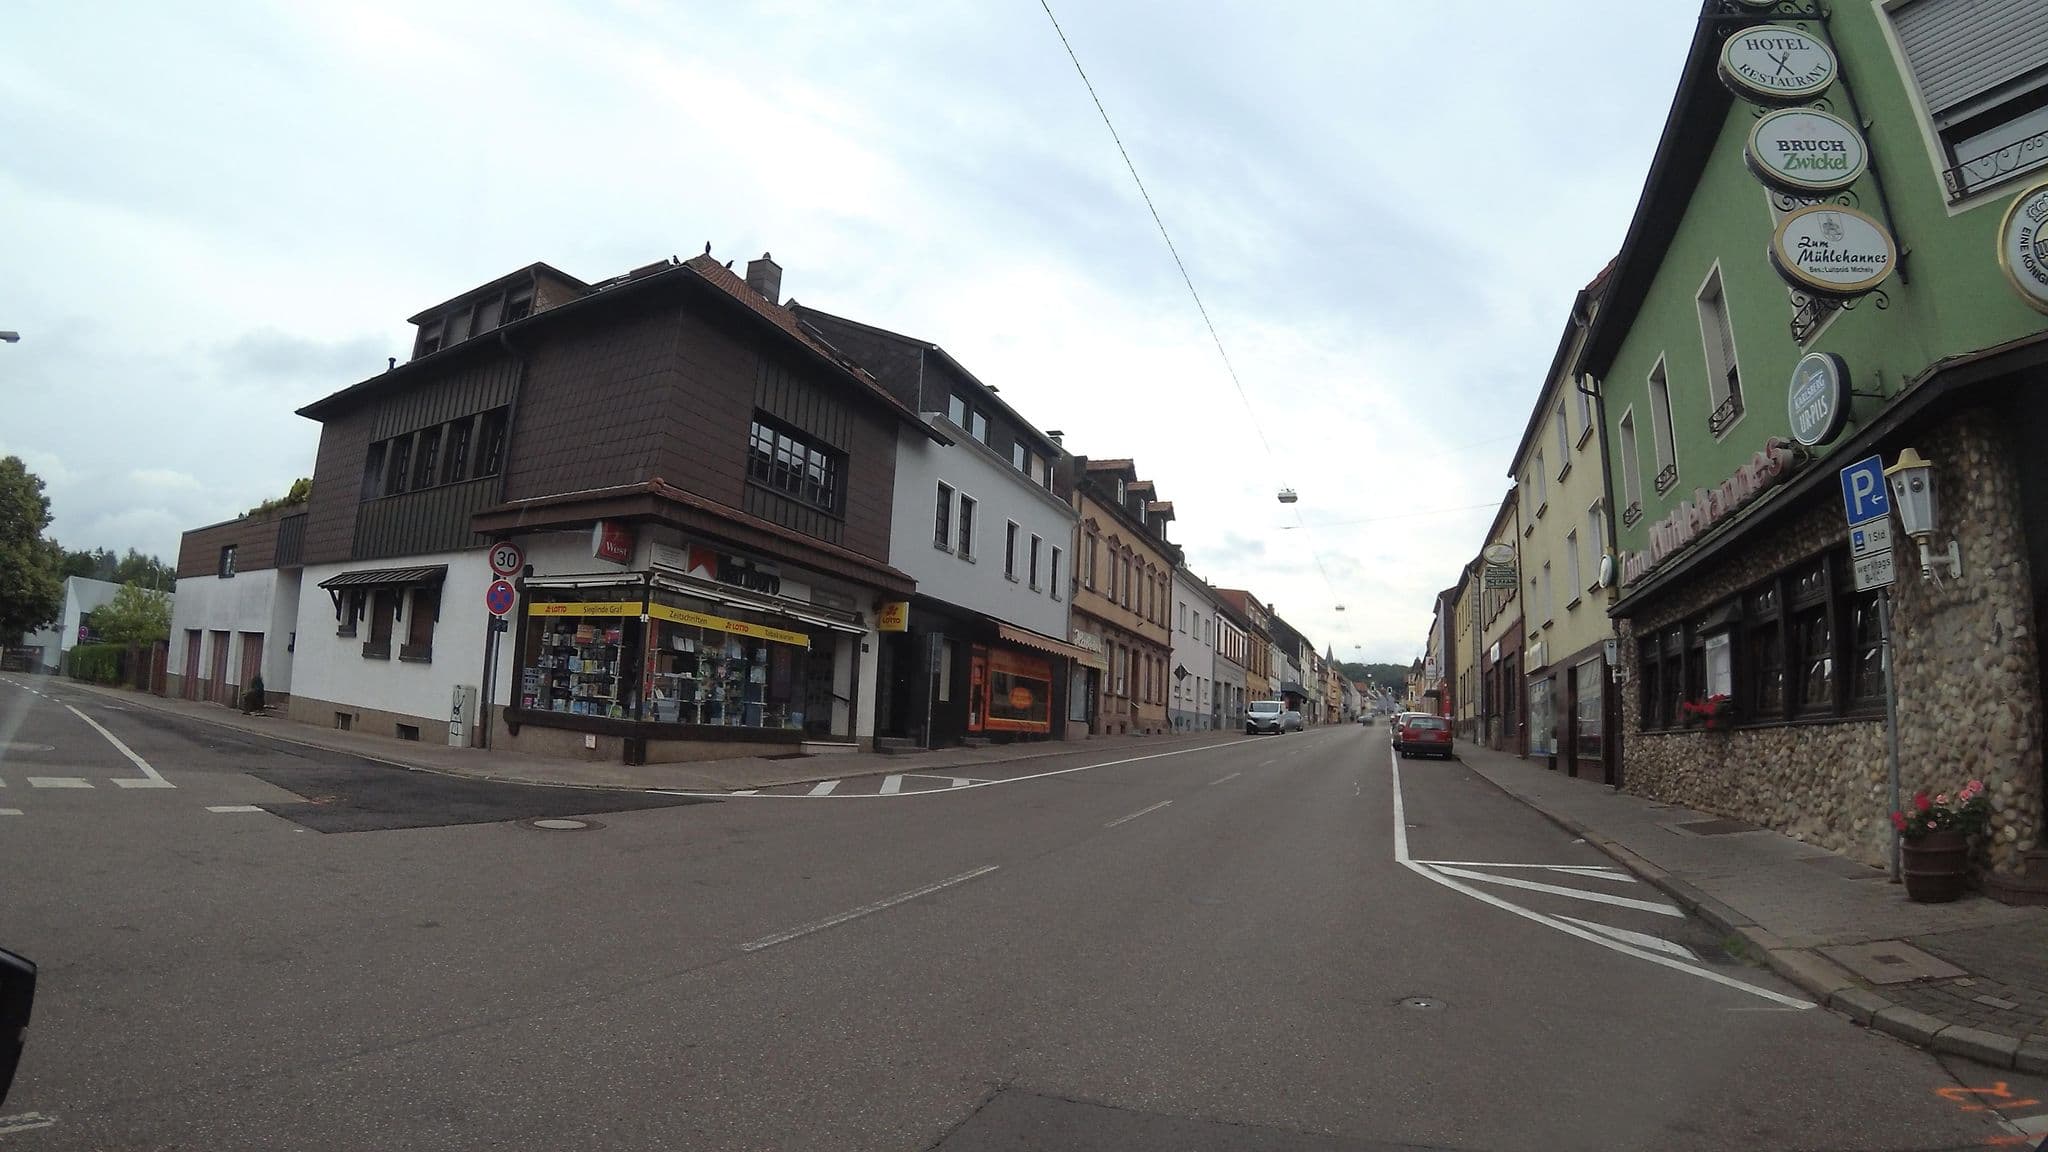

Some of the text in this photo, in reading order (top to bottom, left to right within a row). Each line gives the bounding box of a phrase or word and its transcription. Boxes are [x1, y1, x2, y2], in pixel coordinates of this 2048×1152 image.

[1746, 39, 1810, 50] HOTEL
[1739, 63, 1827, 87] RESTAURANT
[1776, 140, 1847, 151] BRUCH
[1783, 152, 1848, 170] Zwickel
[1797, 236, 1829, 248] Zum
[2019, 226, 2032, 252] EINE
[1797, 248, 1888, 265] Mühlehannes
[1794, 373, 1825, 410] KARLSBERG
[1851, 469, 1874, 515] P
[606, 541, 627, 557] West
[496, 551, 517, 568] 30
[551, 605, 567, 613] LOTTO
[732, 622, 749, 632] LOTTO
[881, 615, 901, 624] LOTTO
